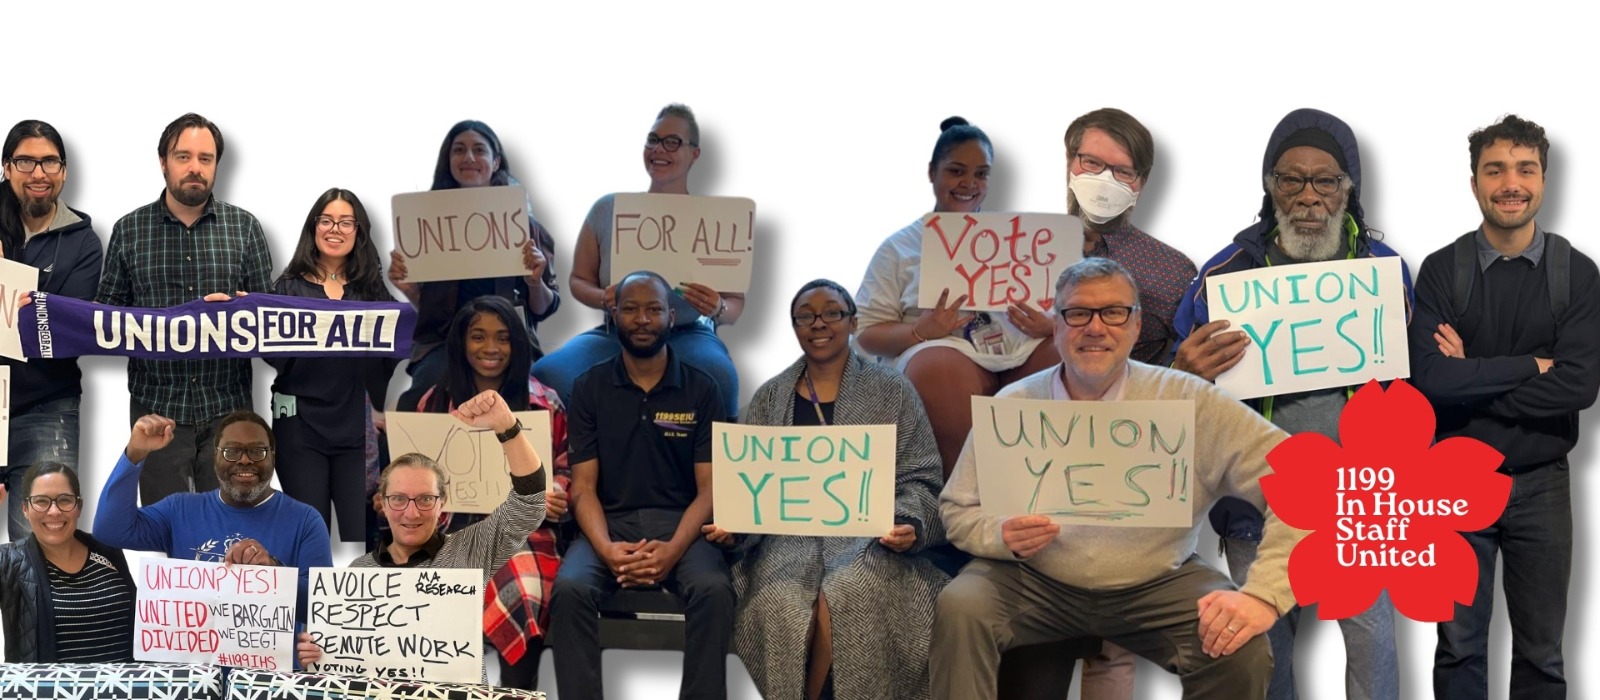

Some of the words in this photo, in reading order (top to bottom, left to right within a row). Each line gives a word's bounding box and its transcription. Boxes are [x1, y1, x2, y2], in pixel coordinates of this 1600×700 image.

[395, 207, 528, 260] UNIONS
[615, 213, 678, 255] FOR
[692, 210, 754, 255] ALL!
[925, 214, 1057, 267] Vote
[1218, 265, 1379, 314] UNION
[93, 309, 257, 353] UNIONS
[263, 311, 317, 340] FOR
[325, 314, 392, 349] ALL
[1242, 304, 1386, 386] YES!!
[990, 405, 1187, 455] UNION
[721, 431, 871, 464] UNION
[737, 468, 874, 526] YES!!
[1024, 456, 1189, 516] YES!!
[230, 567, 277, 595] YES!
[312, 572, 327, 597] A
[333, 571, 402, 598] VOICE
[415, 583, 477, 596] RESEARCH
[417, 571, 441, 583] MA
[138, 599, 208, 628] UNITED
[208, 603, 230, 617] WE
[232, 603, 294, 631] BARGAIN
[311, 601, 431, 628] RESPECT
[141, 629, 220, 653] DIVIDED
[218, 628, 236, 640] WE
[237, 630, 276, 650] BEG!
[310, 631, 391, 656] REMOTE
[397, 633, 476, 659] WORK
[217, 652, 277, 670] #1199IHS
[313, 662, 368, 675] VOTING
